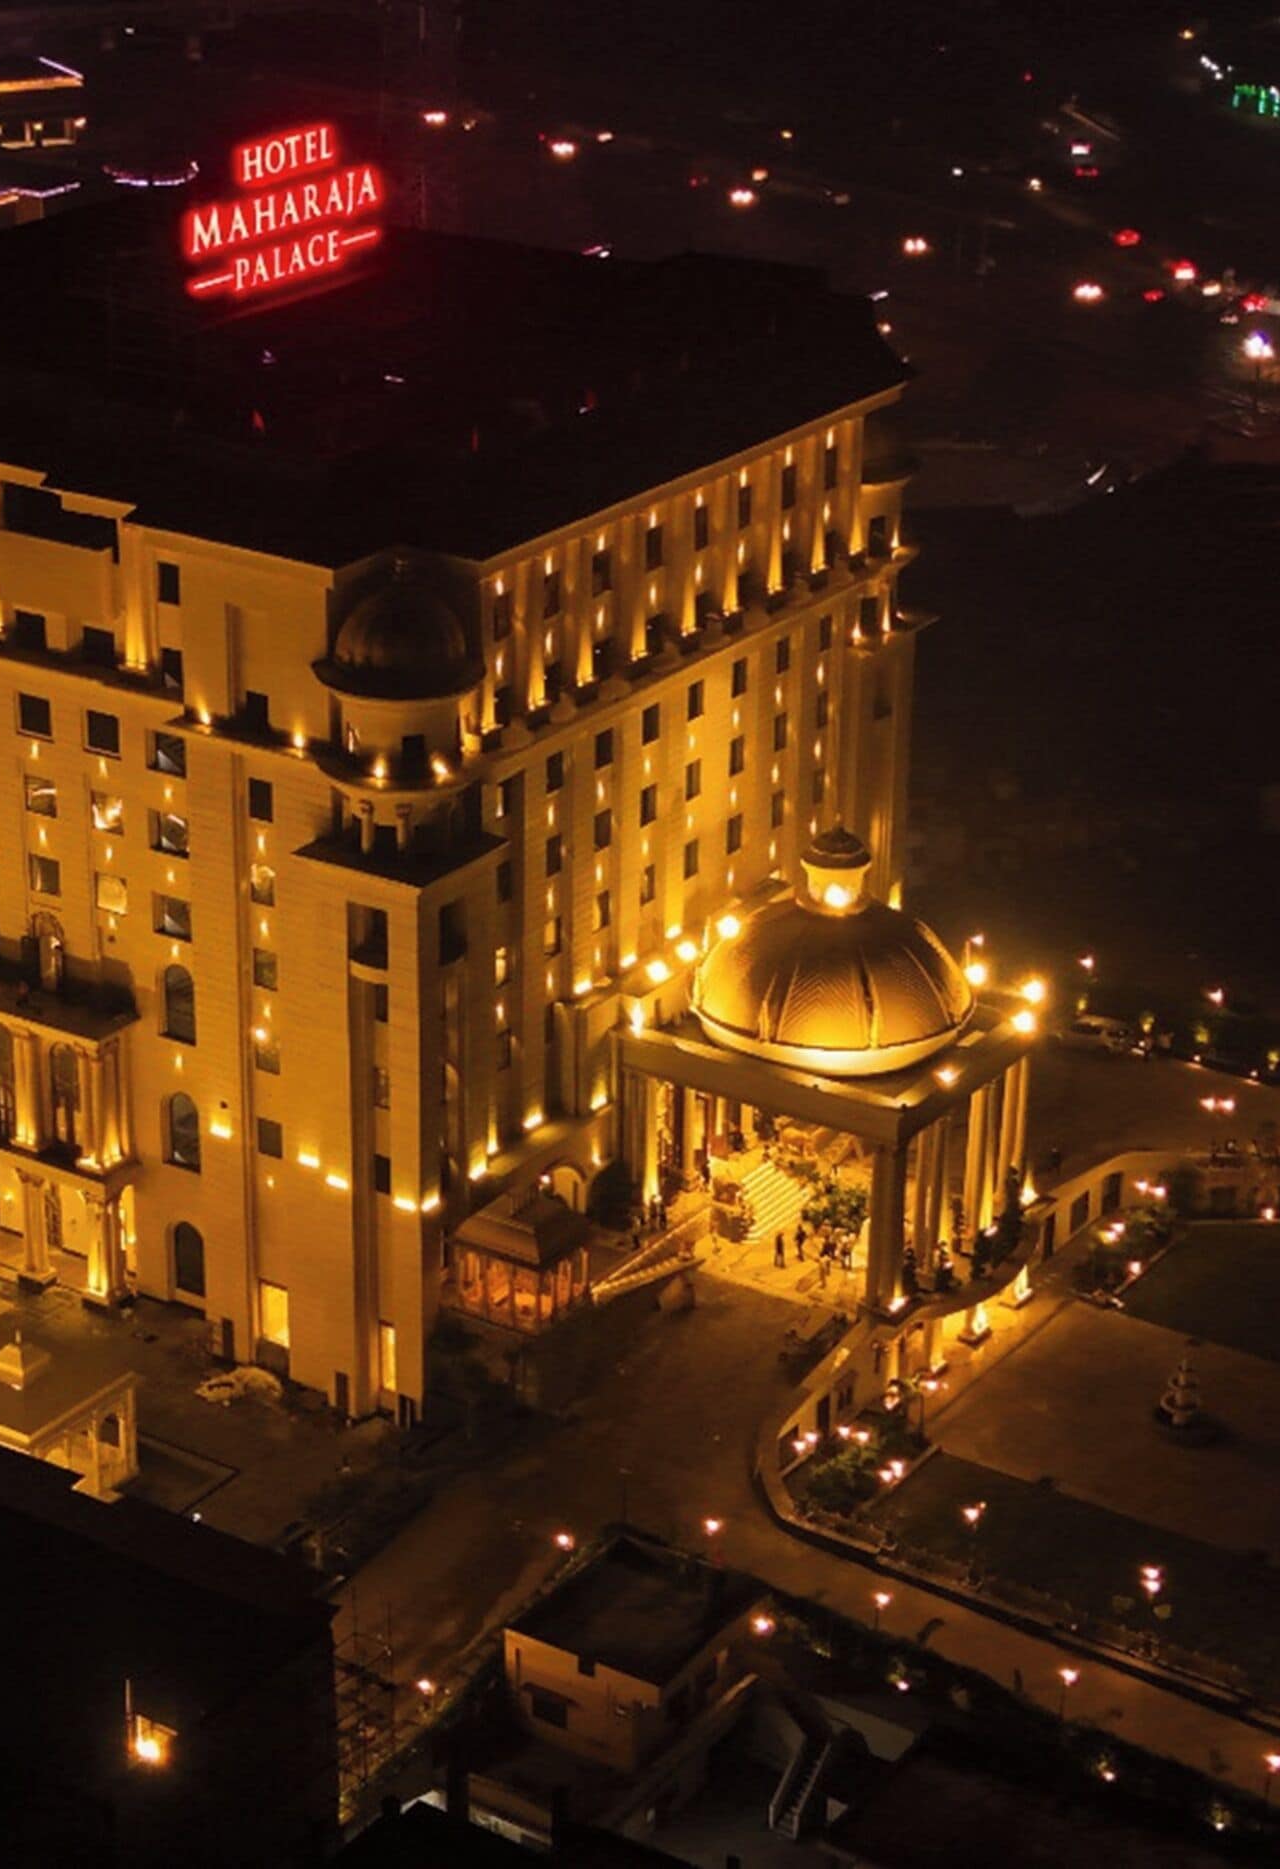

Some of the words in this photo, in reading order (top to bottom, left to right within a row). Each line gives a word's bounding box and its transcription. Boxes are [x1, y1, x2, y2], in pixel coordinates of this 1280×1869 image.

[242, 127, 334, 182] HOTEL
[191, 168, 378, 255] MAHARAJA
[235, 230, 340, 290] PALACE
